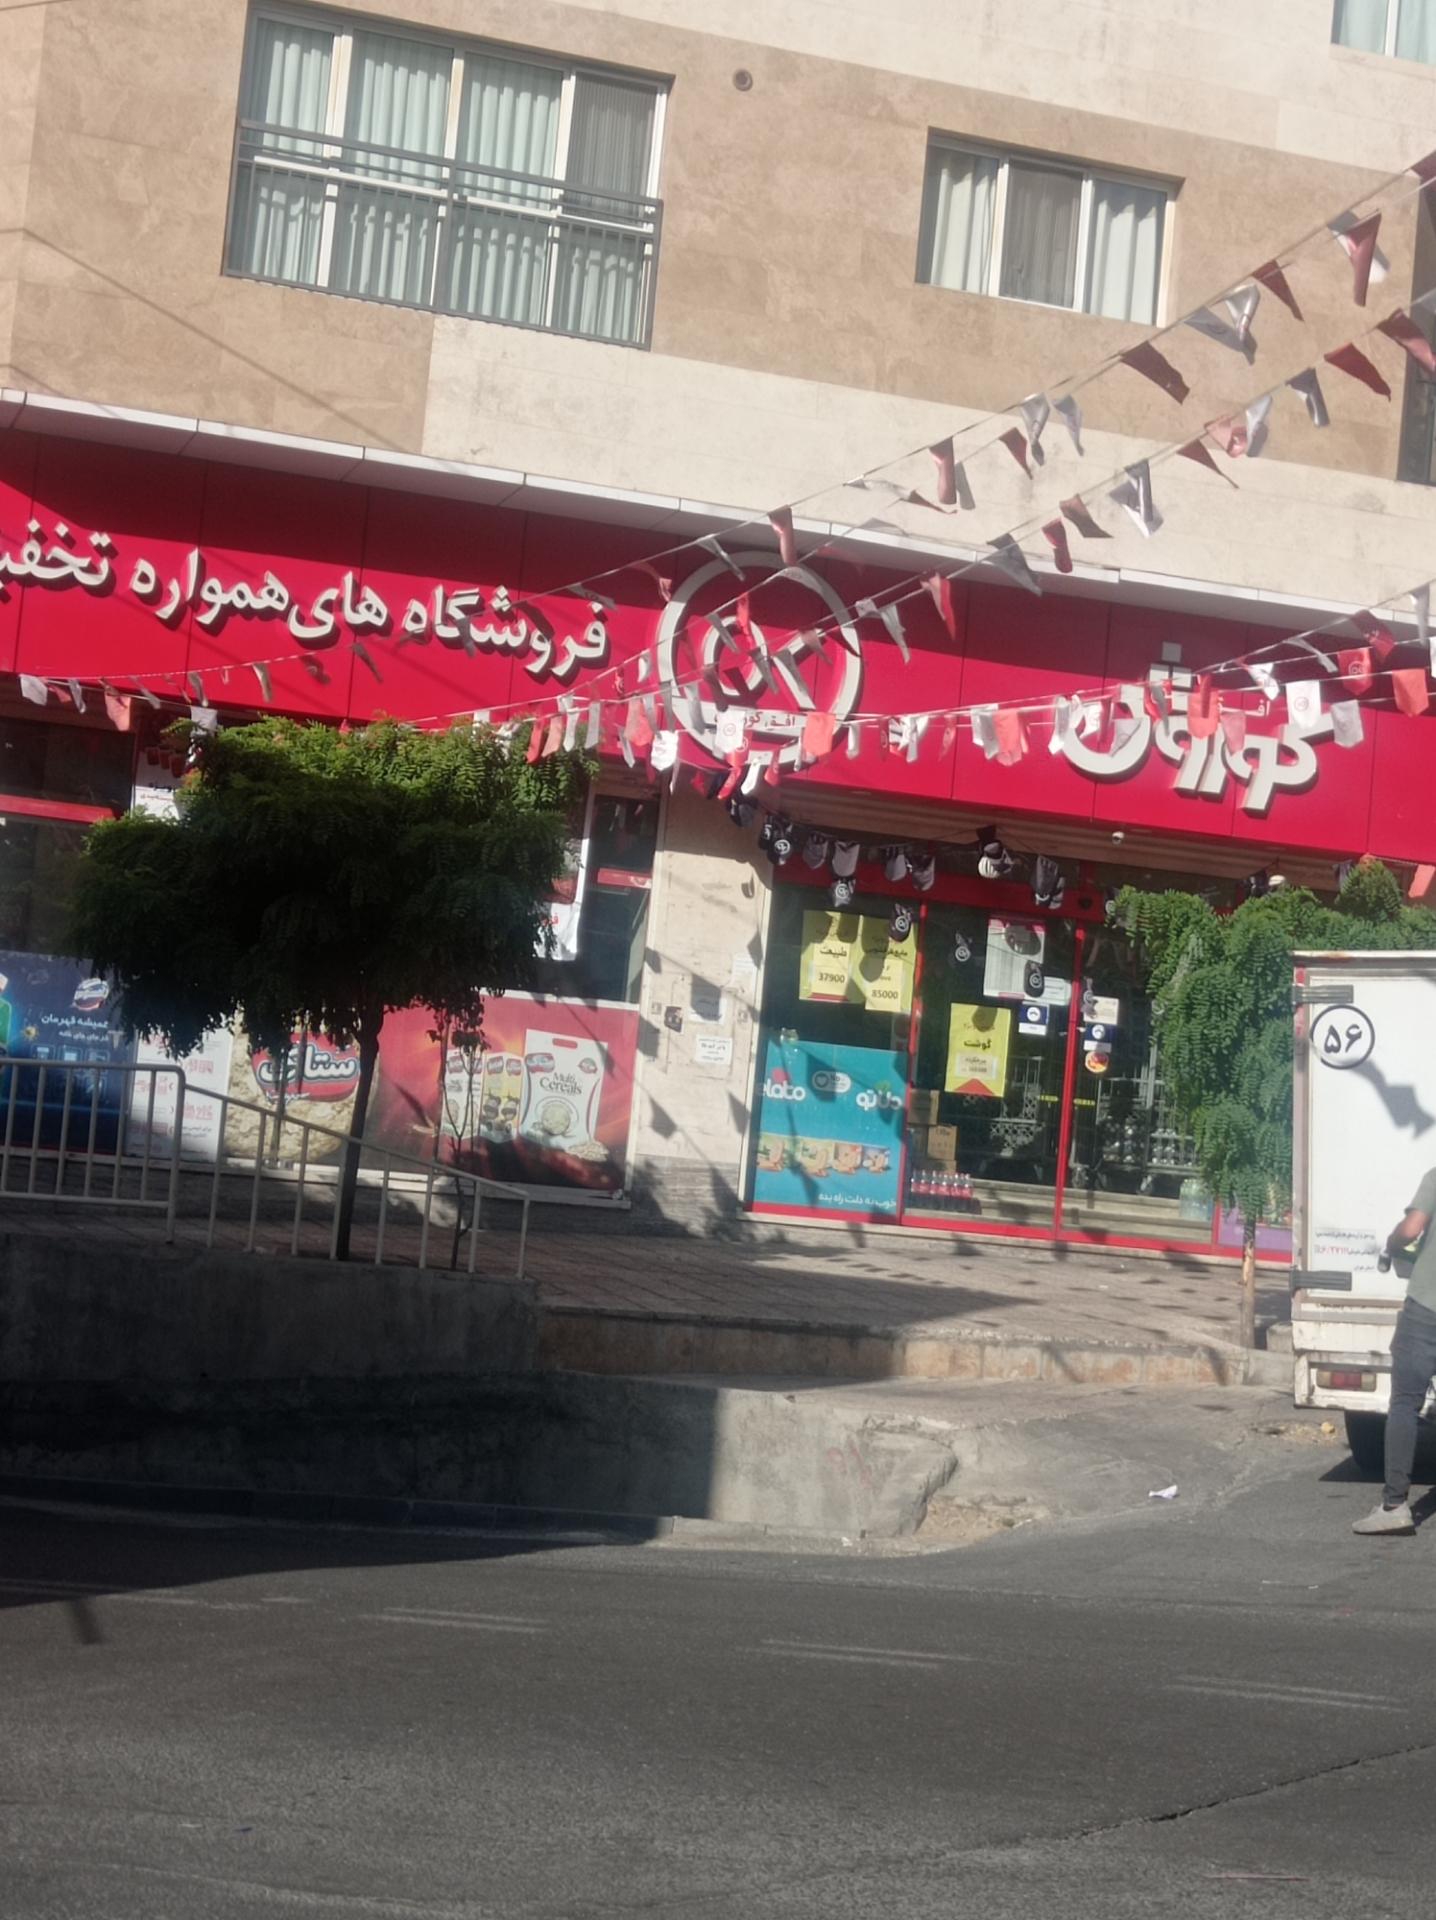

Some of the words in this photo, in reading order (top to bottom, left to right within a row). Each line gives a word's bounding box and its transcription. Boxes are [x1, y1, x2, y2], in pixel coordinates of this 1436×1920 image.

[0, 518, 110, 594] تخفی
[130, 547, 289, 625] همواره
[287, 570, 388, 639] های
[402, 584, 606, 677] فروشگاه
[818, 972, 845, 984] 37900
[1324, 1024, 1362, 1053] ۵۶
[540, 1076, 583, 1097] Cereals
